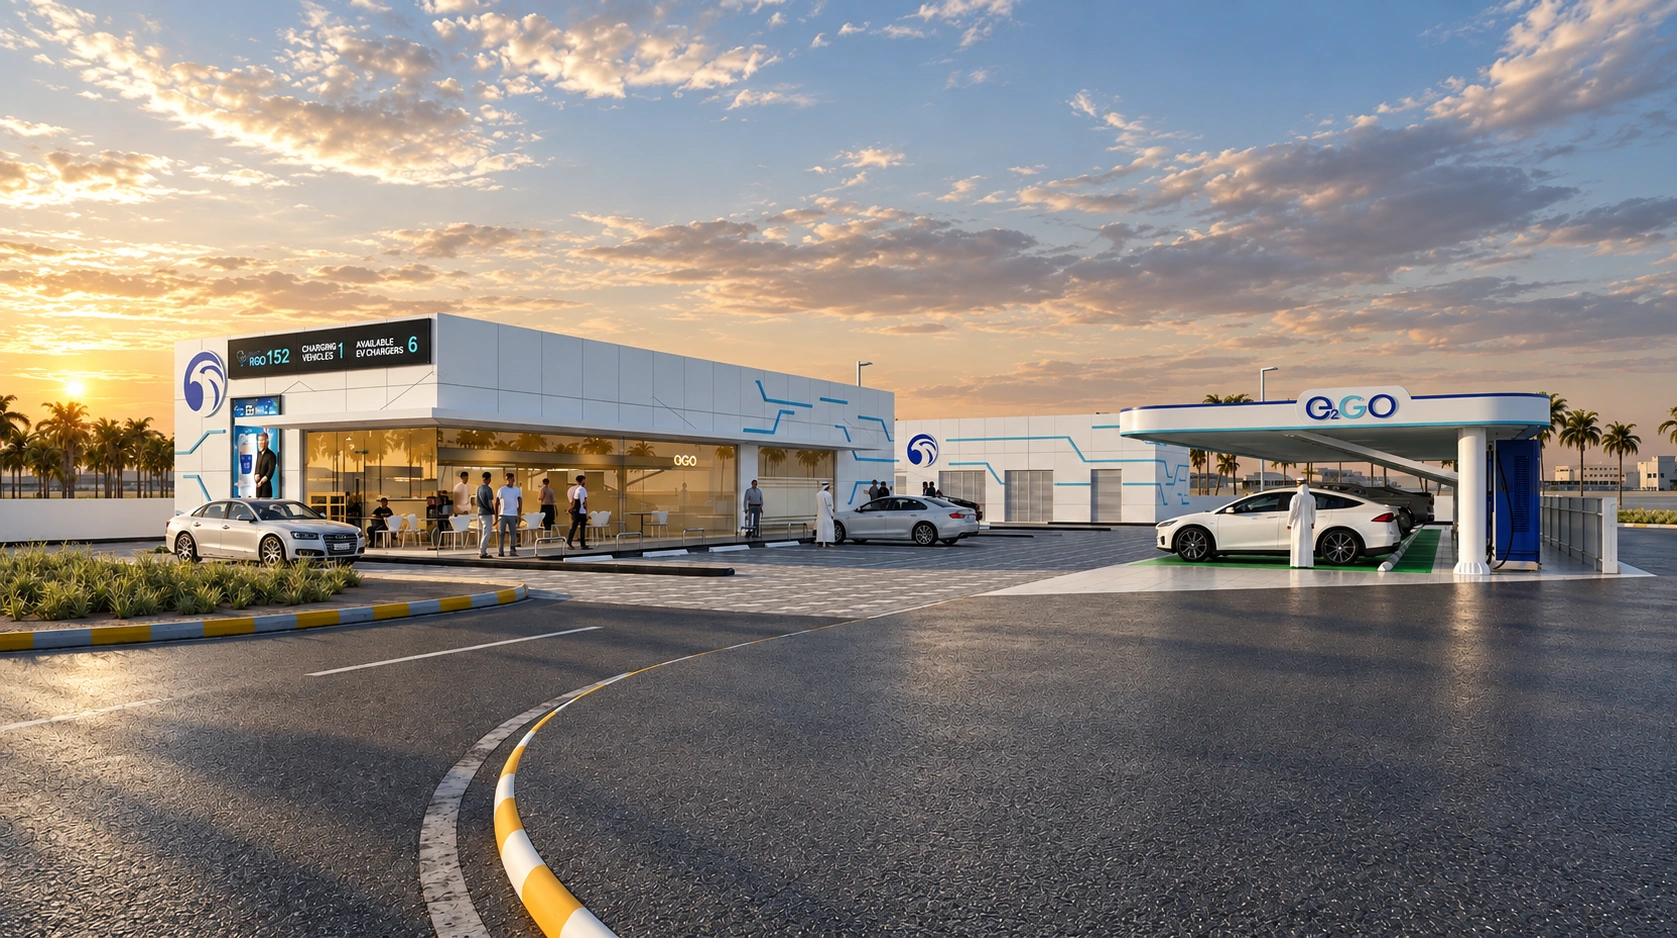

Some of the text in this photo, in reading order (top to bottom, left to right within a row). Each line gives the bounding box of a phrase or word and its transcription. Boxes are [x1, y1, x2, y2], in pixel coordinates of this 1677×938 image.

[356, 338, 394, 348] AVAILABLE
[408, 336, 418, 353] 6
[267, 348, 290, 365] 152
[302, 351, 334, 361] VEHICLES
[338, 342, 343, 359] 1
[356, 346, 404, 358] EV CHARGERS
